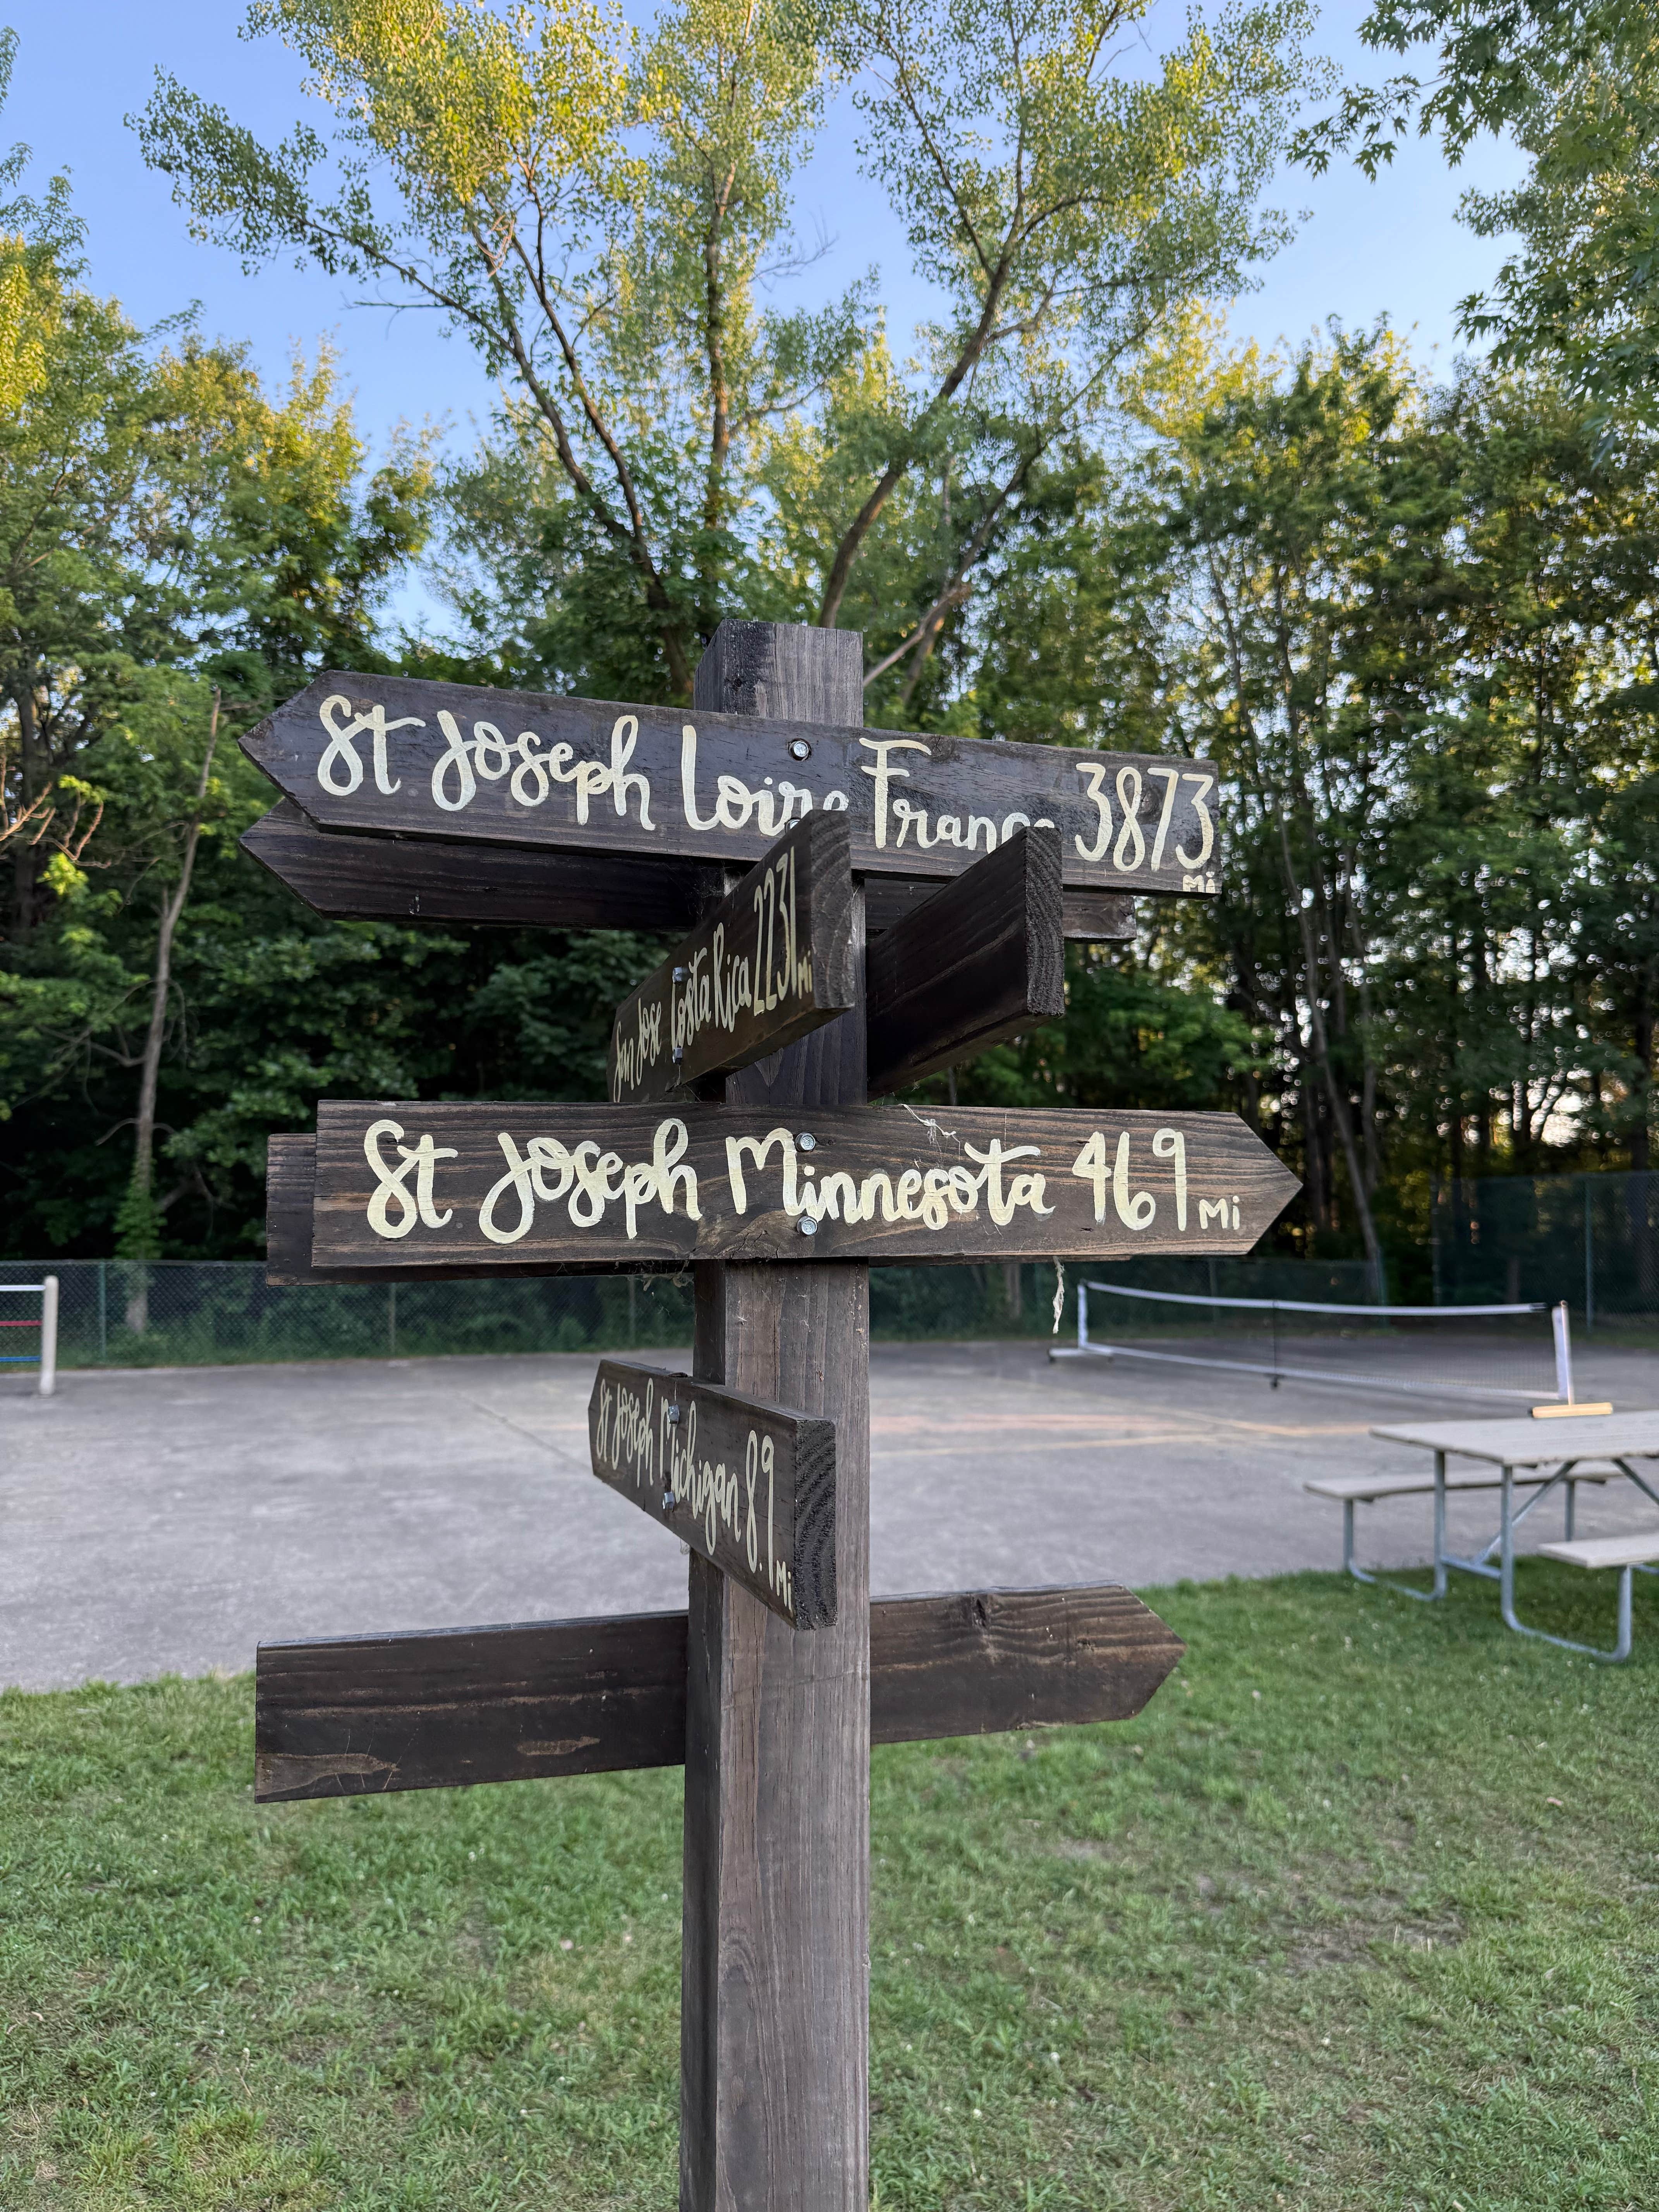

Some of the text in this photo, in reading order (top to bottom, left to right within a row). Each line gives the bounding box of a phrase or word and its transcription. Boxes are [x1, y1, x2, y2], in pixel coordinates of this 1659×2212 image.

[318, 695, 426, 796] St
[432, 709, 657, 831] Joseph
[859, 737, 1055, 854] Franc
[1075, 763, 1214, 872] 3873
[636, 998, 661, 1085] Jose
[714, 922, 752, 1033] Rica
[754, 846, 797, 1017] 2231
[364, 1119, 459, 1239] St
[479, 1118, 703, 1244] Joseph
[726, 1127, 1056, 1230] Minnesota
[1071, 1128, 1187, 1231] 469
[596, 1378, 612, 1462] St
[611, 1377, 654, 1488] Joseph
[660, 1396, 741, 1556] Michigan
